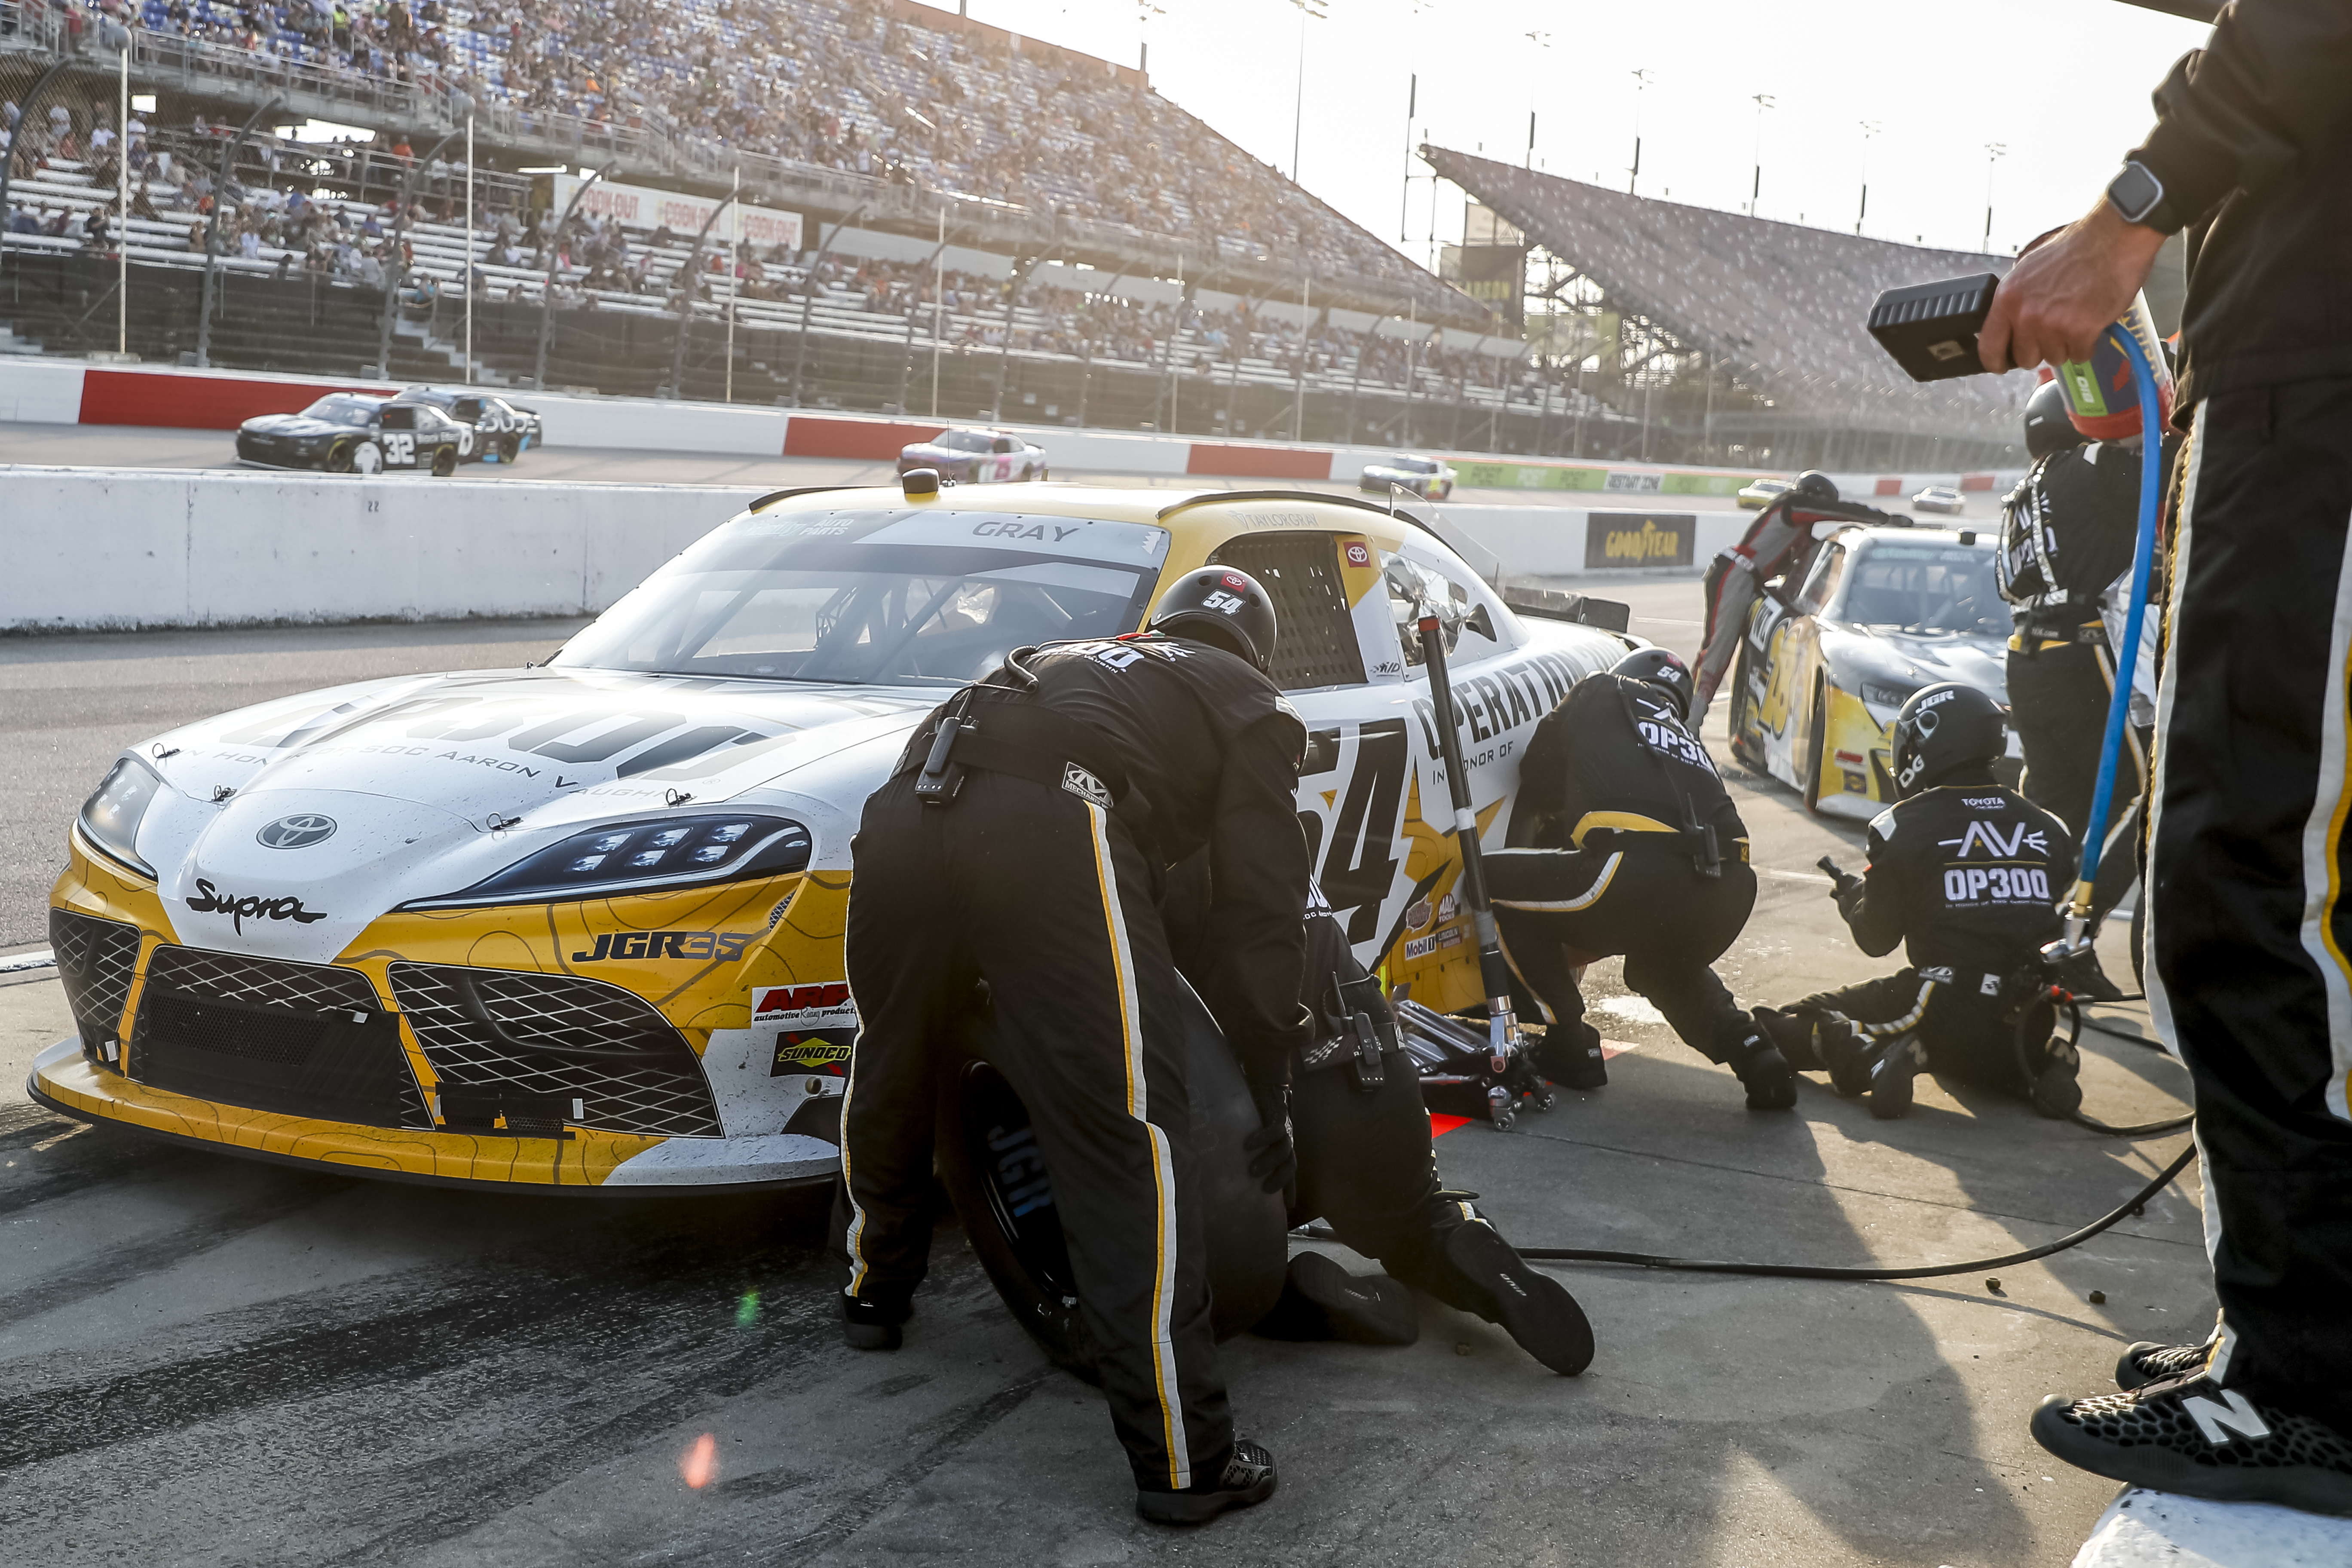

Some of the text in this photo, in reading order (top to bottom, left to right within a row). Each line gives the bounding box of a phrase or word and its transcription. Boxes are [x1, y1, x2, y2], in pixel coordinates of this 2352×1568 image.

[615, 194, 640, 219] OUT
[665, 201, 696, 229] COOK
[744, 214, 798, 243] COOK OUT
[383, 433, 416, 464] 32
[798, 527, 848, 536] PARTS
[972, 521, 1080, 542] GRAY
[1605, 527, 1679, 559] GOODYEAR
[1202, 590, 1244, 615] 54
[1657, 665, 1681, 683] 54
[1915, 689, 1954, 714] JGR
[358, 745, 430, 757] SOC
[435, 750, 541, 778] AARON
[1463, 748, 1494, 772] ONOR
[1499, 740, 1513, 758] OF
[1065, 780, 1101, 805] MECHANIX
[1961, 797, 2006, 806] TOYOTA
[1944, 868, 2050, 900] OP300
[186, 878, 328, 937] Supra
[1406, 938, 1427, 959] Mobil
[755, 984, 850, 1013] ARP
[754, 1012, 799, 1021] automotive
[821, 1007, 857, 1017] product
[780, 1046, 849, 1060] SUNOCO
[2181, 1389, 2270, 1444] N
